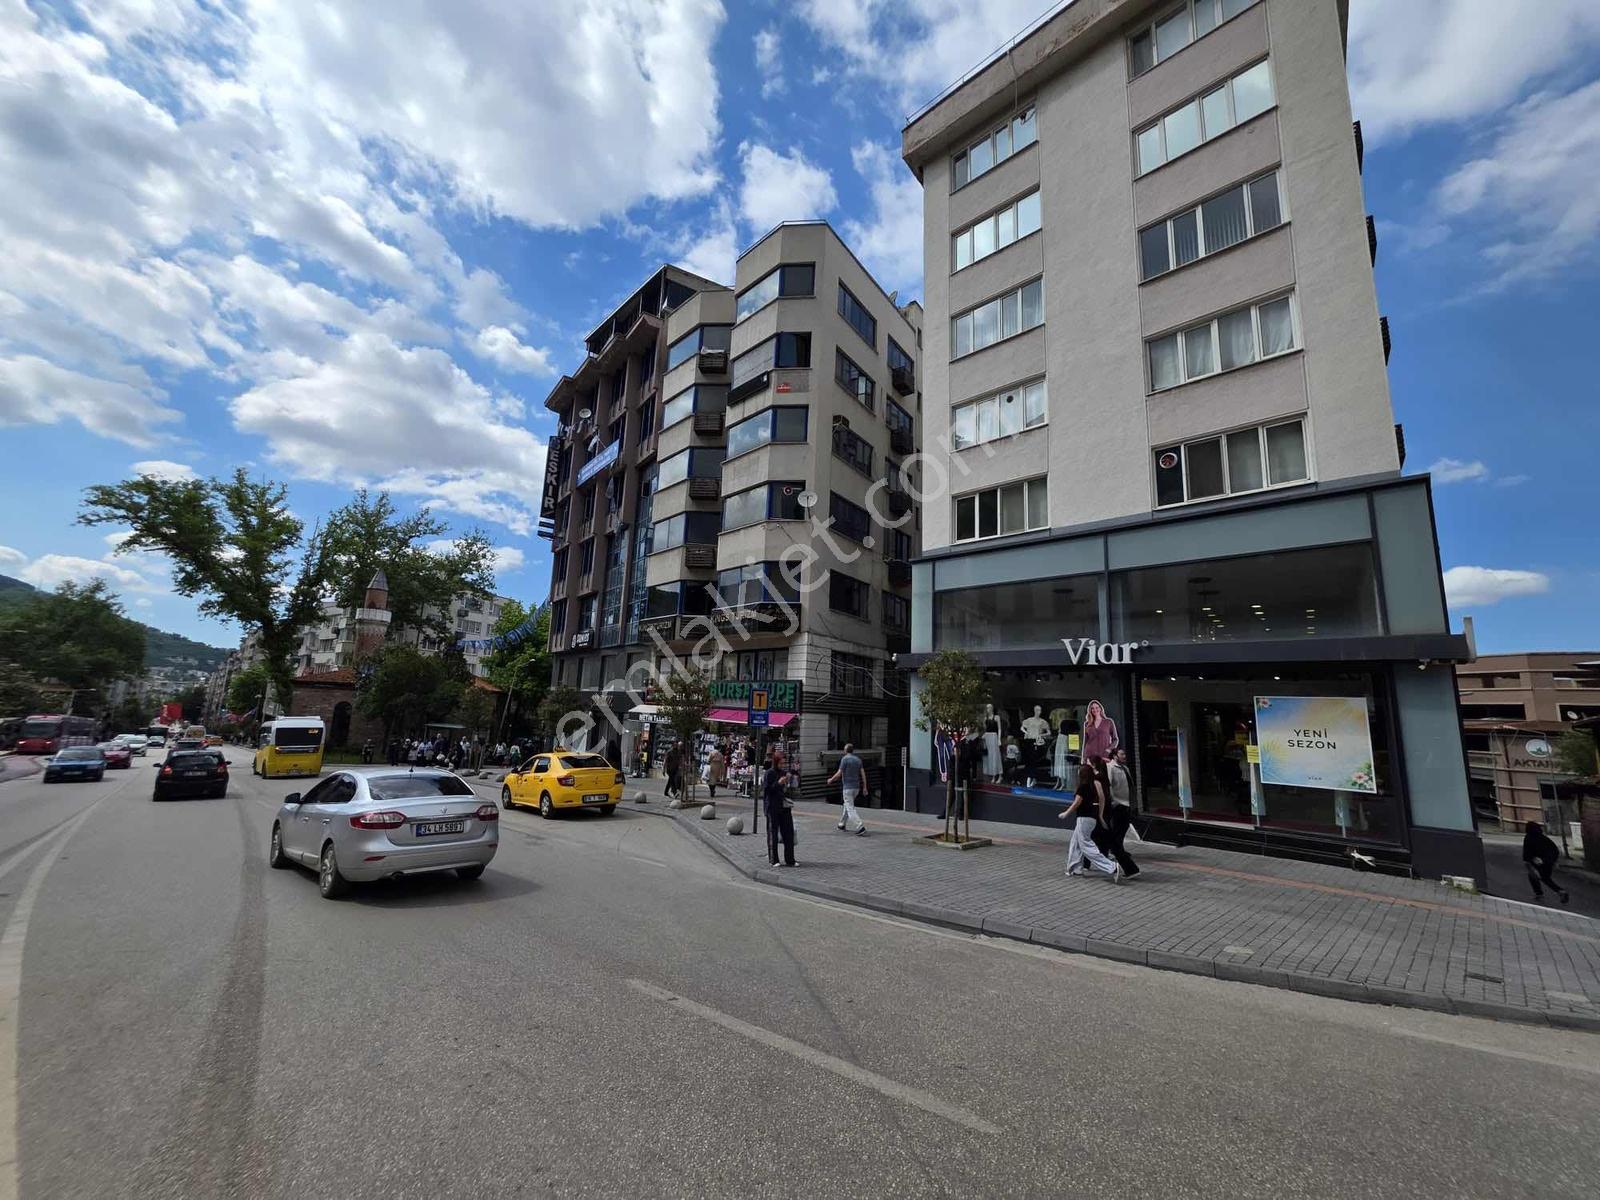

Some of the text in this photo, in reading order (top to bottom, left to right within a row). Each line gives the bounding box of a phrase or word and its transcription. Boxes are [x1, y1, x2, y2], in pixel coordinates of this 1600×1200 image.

[1060, 638, 1139, 665] Viar
[1287, 739, 1337, 750] SEZON
[422, 824, 431, 834] 34
